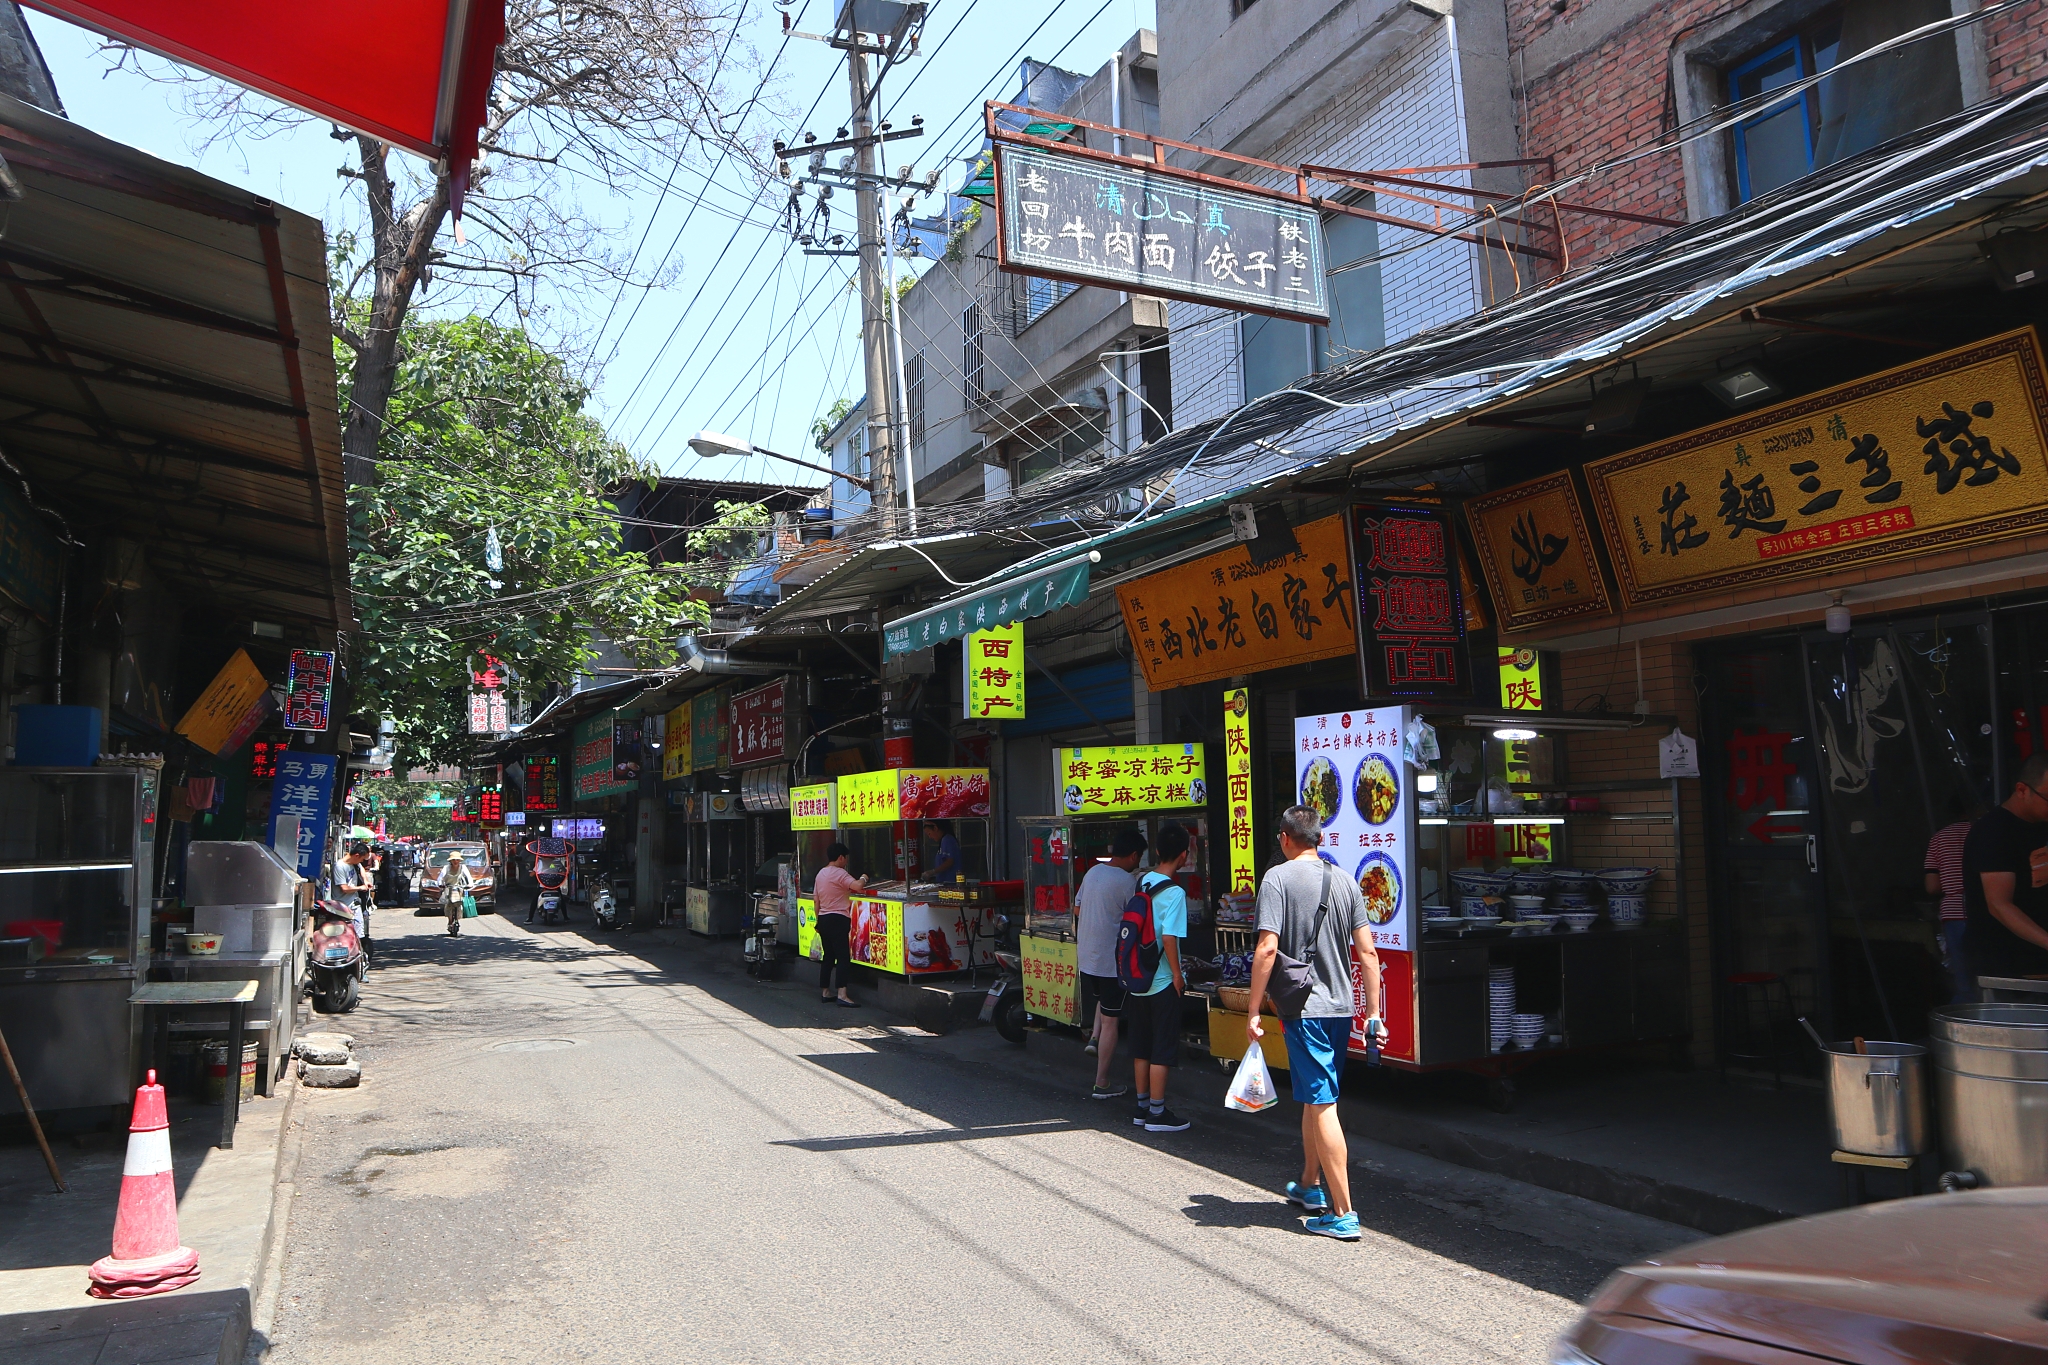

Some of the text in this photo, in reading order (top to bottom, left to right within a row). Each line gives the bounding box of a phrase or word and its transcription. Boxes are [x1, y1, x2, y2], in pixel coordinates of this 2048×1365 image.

[1017, 169, 1051, 251] 老回坊
[1097, 182, 1124, 216] 清
[1202, 203, 1230, 236] 真
[1058, 216, 1276, 289] 牛肉面 饺子
[1278, 216, 1310, 295] 铁老三
[1826, 413, 1848, 442] 清
[1735, 442, 1752, 468] 真
[1210, 567, 1226, 587] 清
[1522, 579, 1579, 604] 回坊一绝
[1130, 596, 1163, 673] 陕西特产
[979, 624, 1014, 716] 西特产
[293, 673, 327, 725] 牛羊肉
[1317, 713, 1375, 729] 清 真
[282, 761, 329, 779] 马勇
[1068, 755, 1201, 781] 蜂蜜凉粽子
[543, 765, 557, 803] 肉丸糊辣汤
[903, 773, 986, 798] 富平柿饼
[1083, 782, 1189, 807] 芝麻凉糕
[840, 788, 896, 816] 陕西富平柿饼
[1227, 724, 1254, 896] 陕西特产
[1358, 832, 1397, 848] 拉条子
[1023, 956, 1076, 987] 蜂蜜凉粽子
[1025, 984, 1074, 1018] 芝麻凉糕
